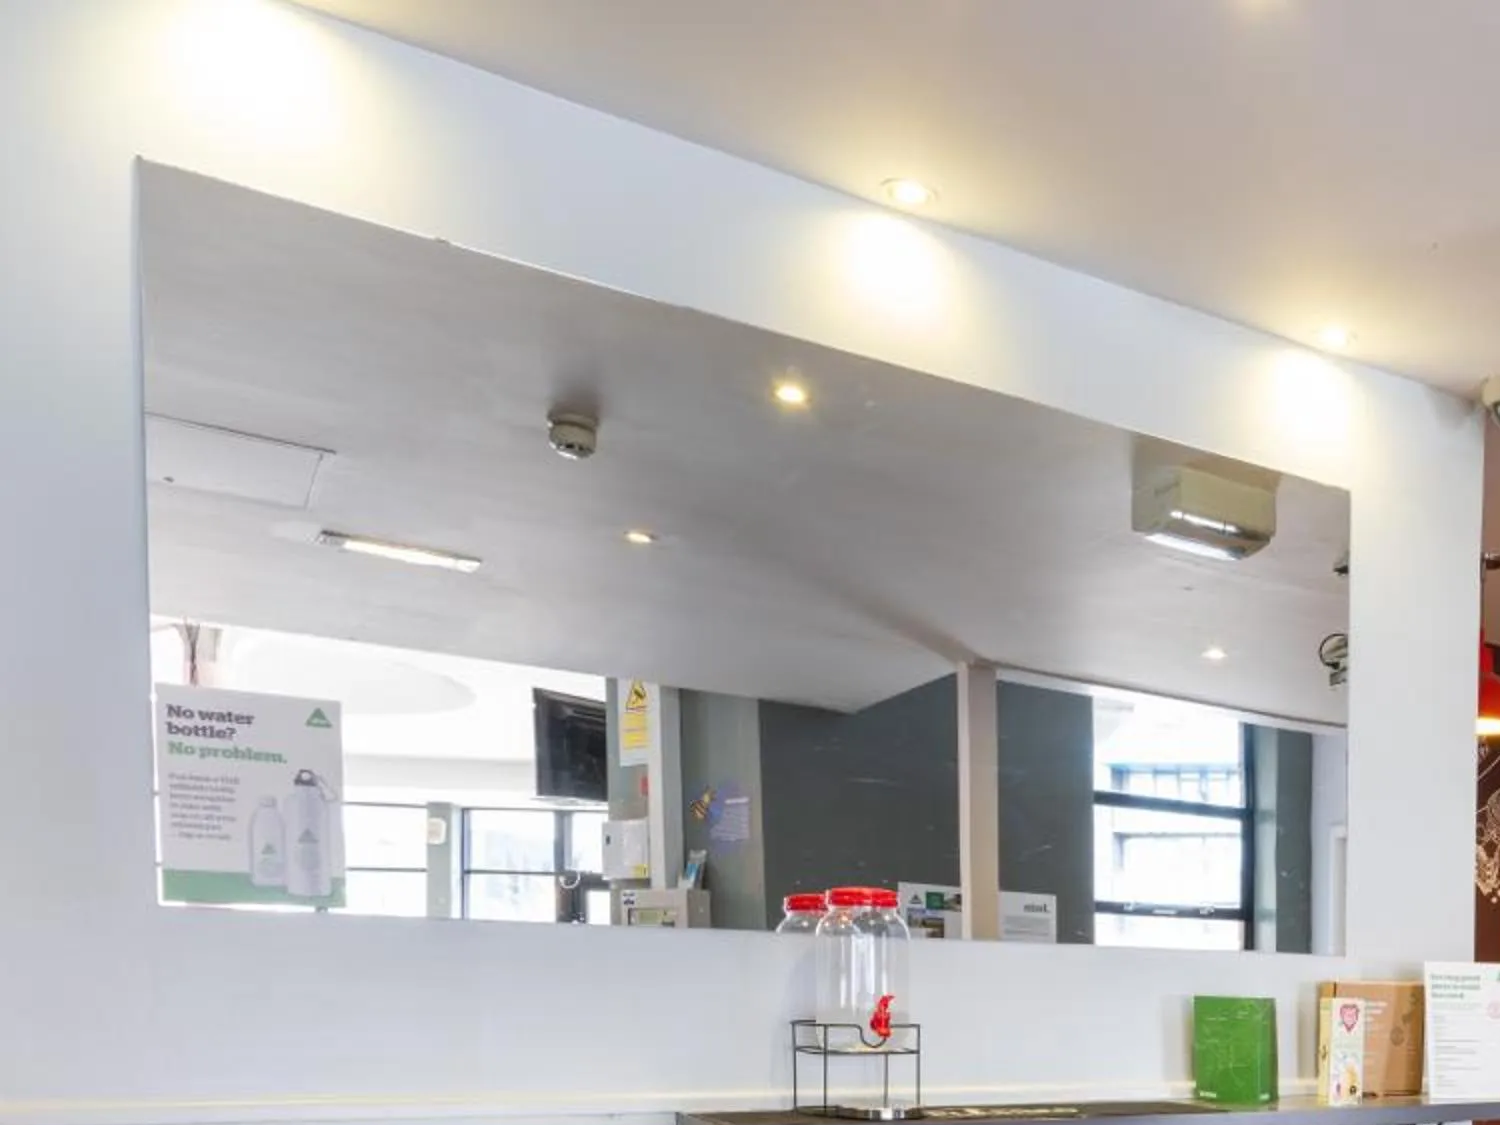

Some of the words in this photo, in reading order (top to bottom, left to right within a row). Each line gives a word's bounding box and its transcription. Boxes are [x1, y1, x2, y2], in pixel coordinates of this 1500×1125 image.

[166, 704, 194, 719] No
[198, 709, 255, 725] water
[166, 721, 237, 740] bottle?
[168, 741, 195, 755] No
[199, 743, 287, 764] problem.
